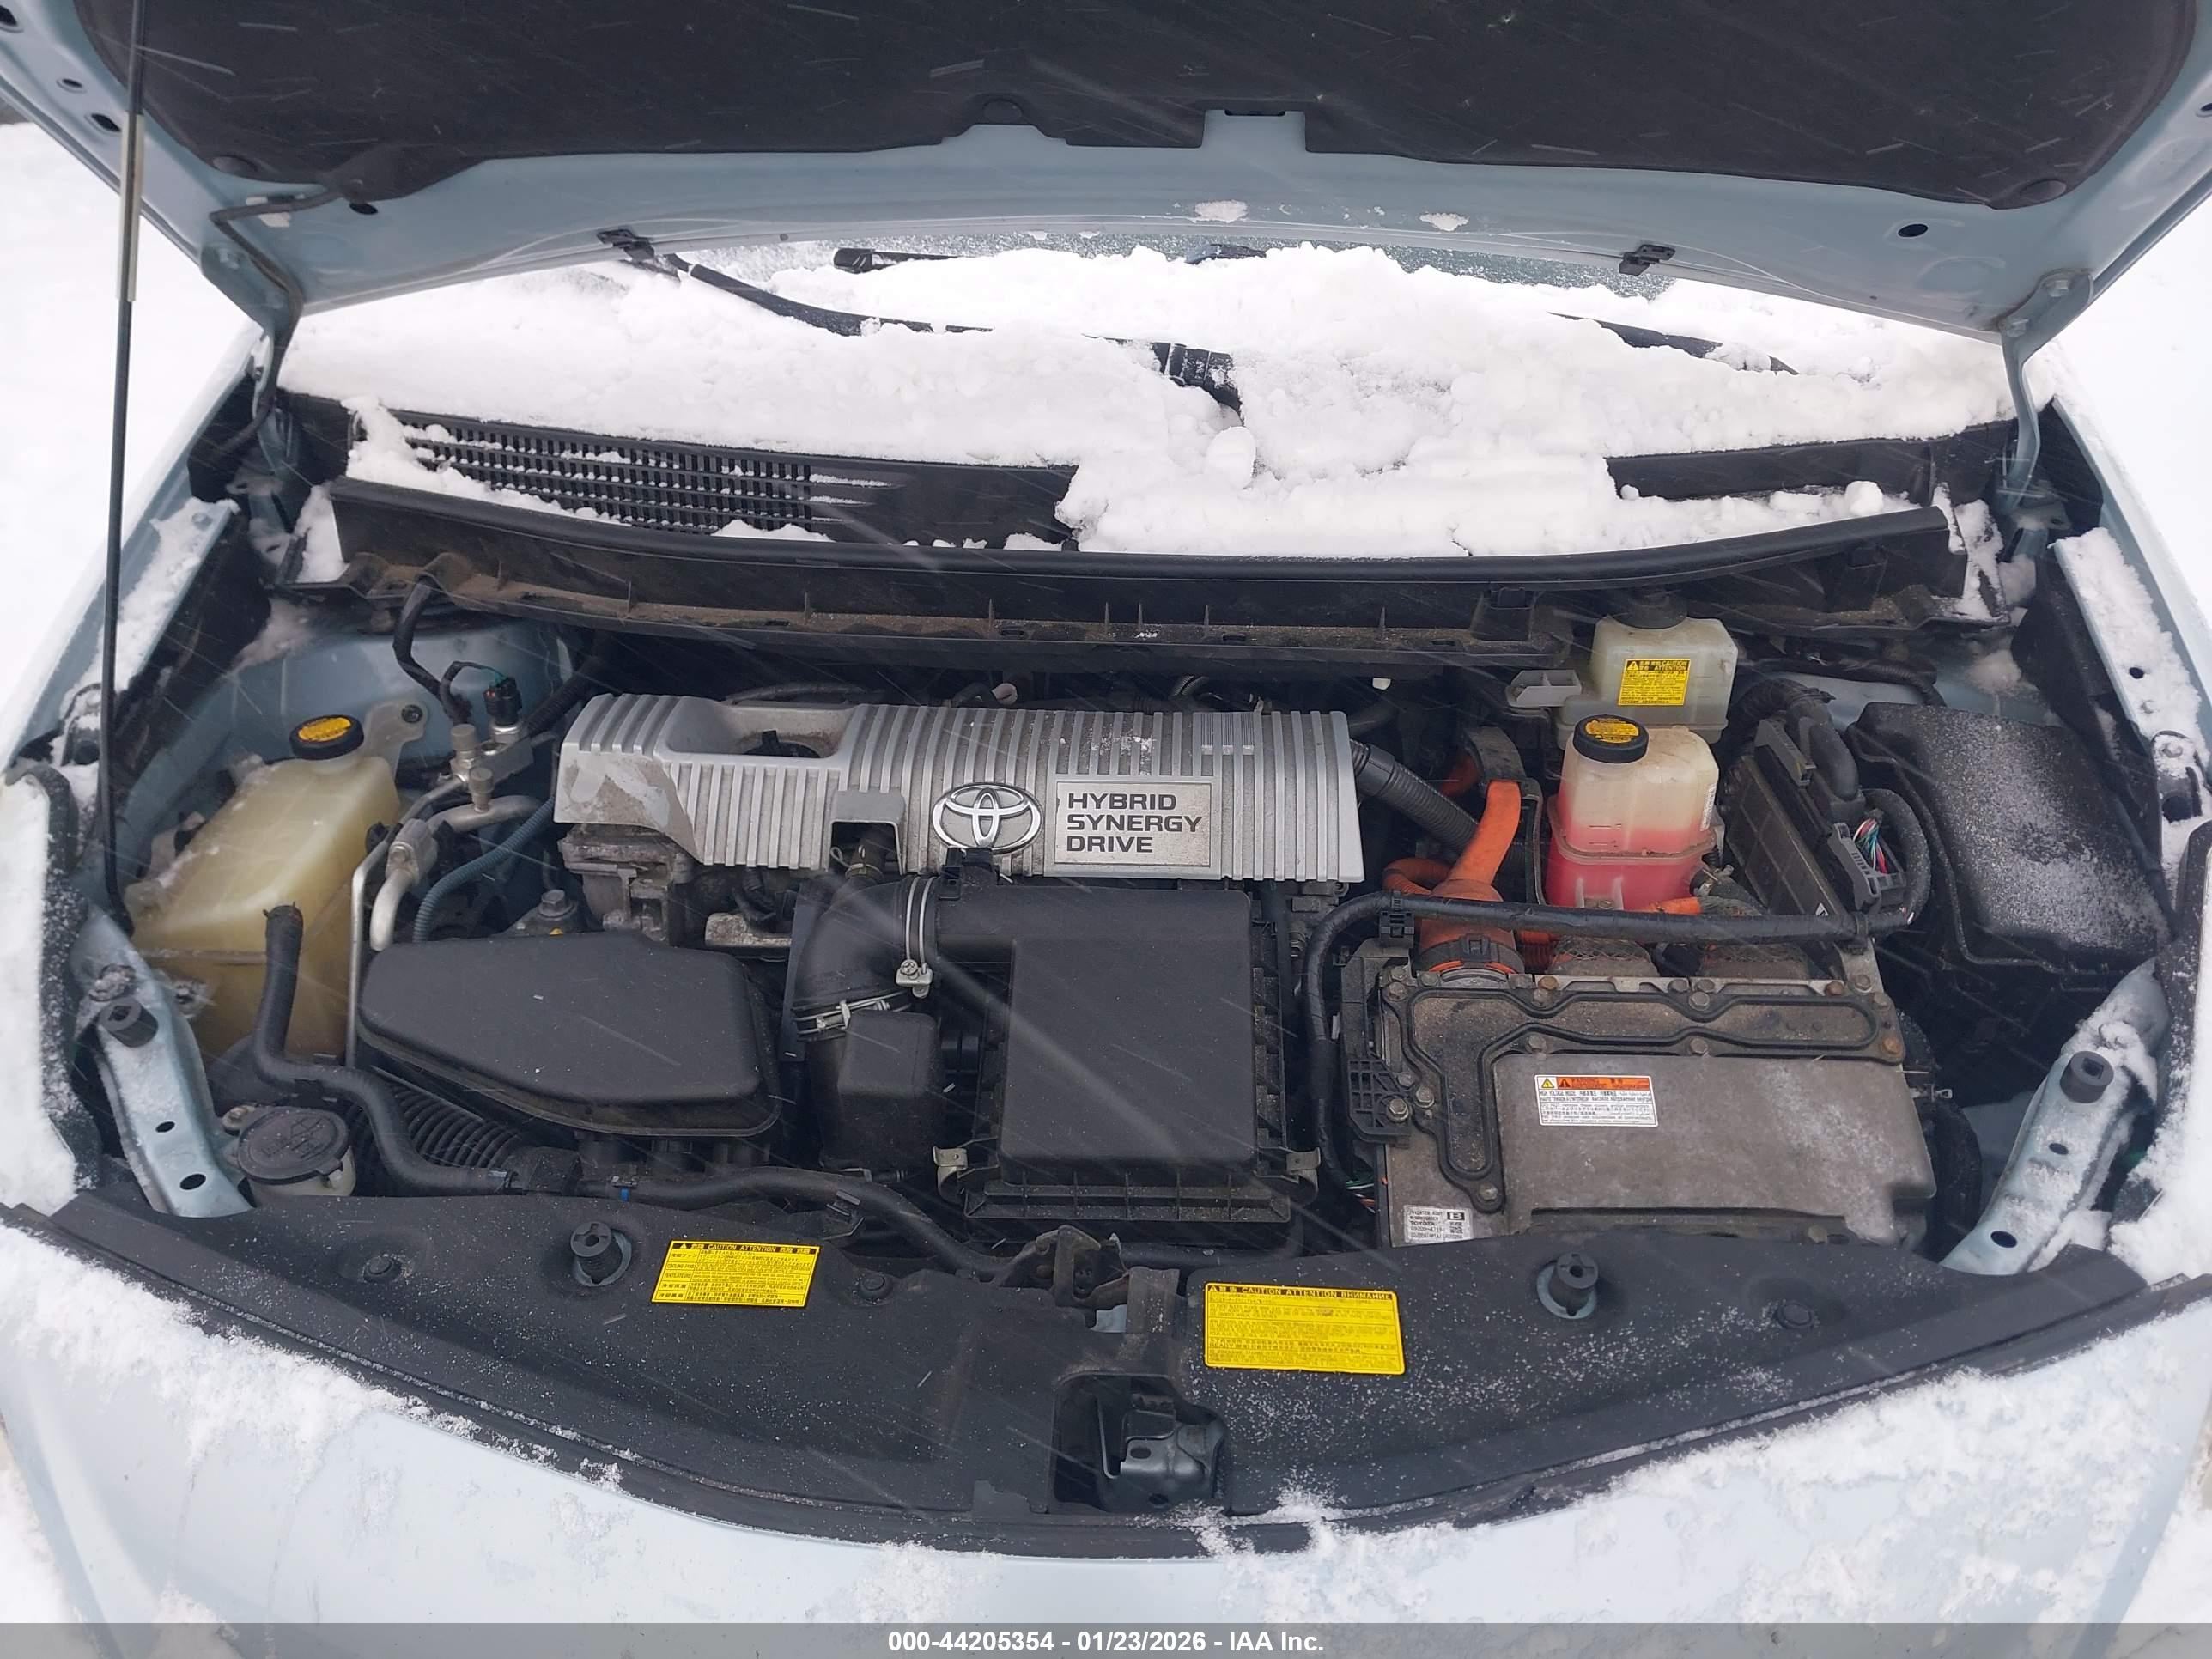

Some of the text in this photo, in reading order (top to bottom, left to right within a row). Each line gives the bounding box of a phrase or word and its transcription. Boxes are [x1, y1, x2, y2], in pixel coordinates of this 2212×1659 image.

[1067, 793, 1176, 811] HYBRID
[1066, 814, 1203, 832] SYNERGY
[1066, 836, 1153, 854] DRIVE
[739, 1244, 777, 1253] ATTENTION
[1285, 1289, 1338, 1298] ATTENTION
